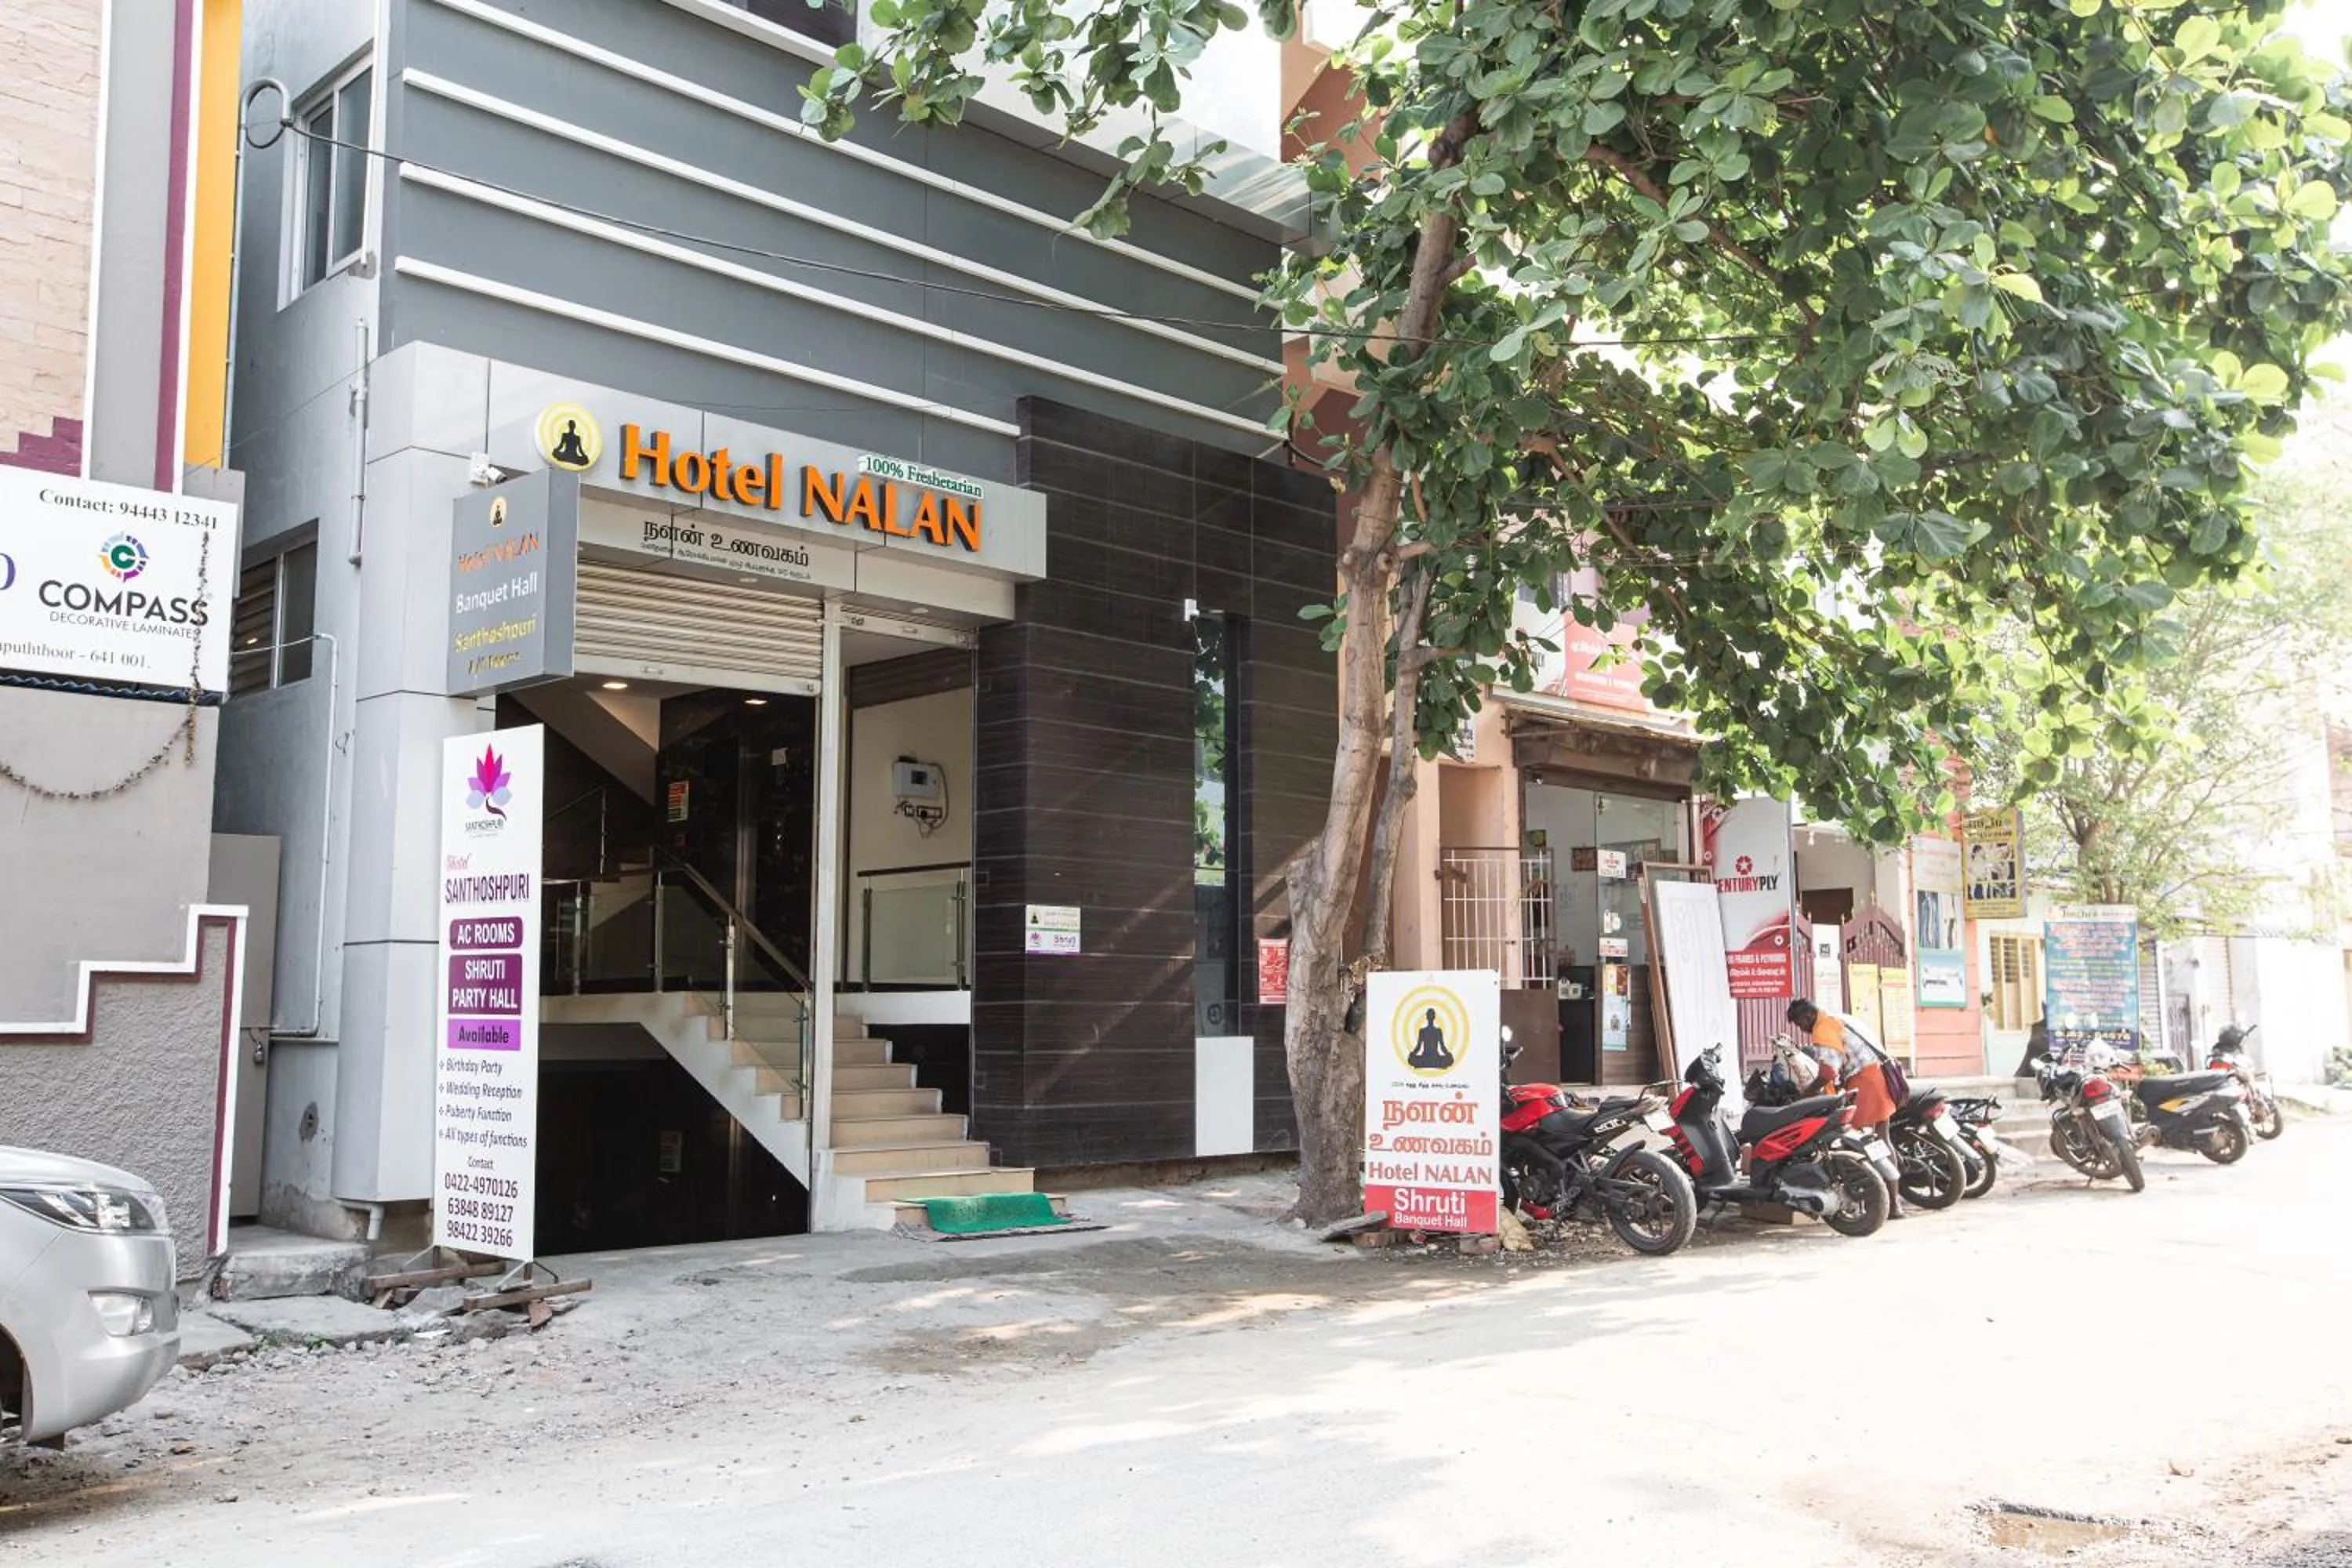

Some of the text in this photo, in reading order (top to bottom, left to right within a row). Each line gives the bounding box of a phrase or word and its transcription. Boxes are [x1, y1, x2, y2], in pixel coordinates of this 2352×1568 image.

[866, 456, 904, 477] 100%
[621, 423, 982, 552] Hotel NALAN
[39, 488, 114, 514] Contact:
[120, 502, 167, 521] 94443
[644, 521, 705, 546] நளன்
[710, 533, 809, 566] உணவகம்
[39, 579, 209, 626] COMPASS
[456, 572, 537, 613] Banquet Hall
[49, 611, 129, 630] DECORATIVE
[90, 650, 114, 664] 641
[445, 873, 529, 903] SANTHOSHPURI
[457, 923, 515, 944] AC ROOMS
[465, 960, 506, 980] SHRUTI
[452, 989, 517, 1008] PARTY HALL
[459, 1025, 509, 1044] Available
[447, 1058, 503, 1076] Birthday Party
[447, 1081, 522, 1101] Wedding Reception
[446, 1104, 512, 1122] Puberty Function
[1382, 1091, 1478, 1131] நளன்
[445, 1127, 528, 1148] All types of functions
[1369, 1131, 1494, 1157] உணவகம்
[468, 1156, 494, 1170] Contact
[1370, 1162, 1493, 1185] Hotel NALAN
[445, 1172, 518, 1199] 0422-4970126
[448, 1197, 514, 1223] 63848 89127
[1394, 1188, 1466, 1215] Shruti
[1394, 1213, 1468, 1229] Banquet Hall
[448, 1220, 513, 1247] 98422 39266
